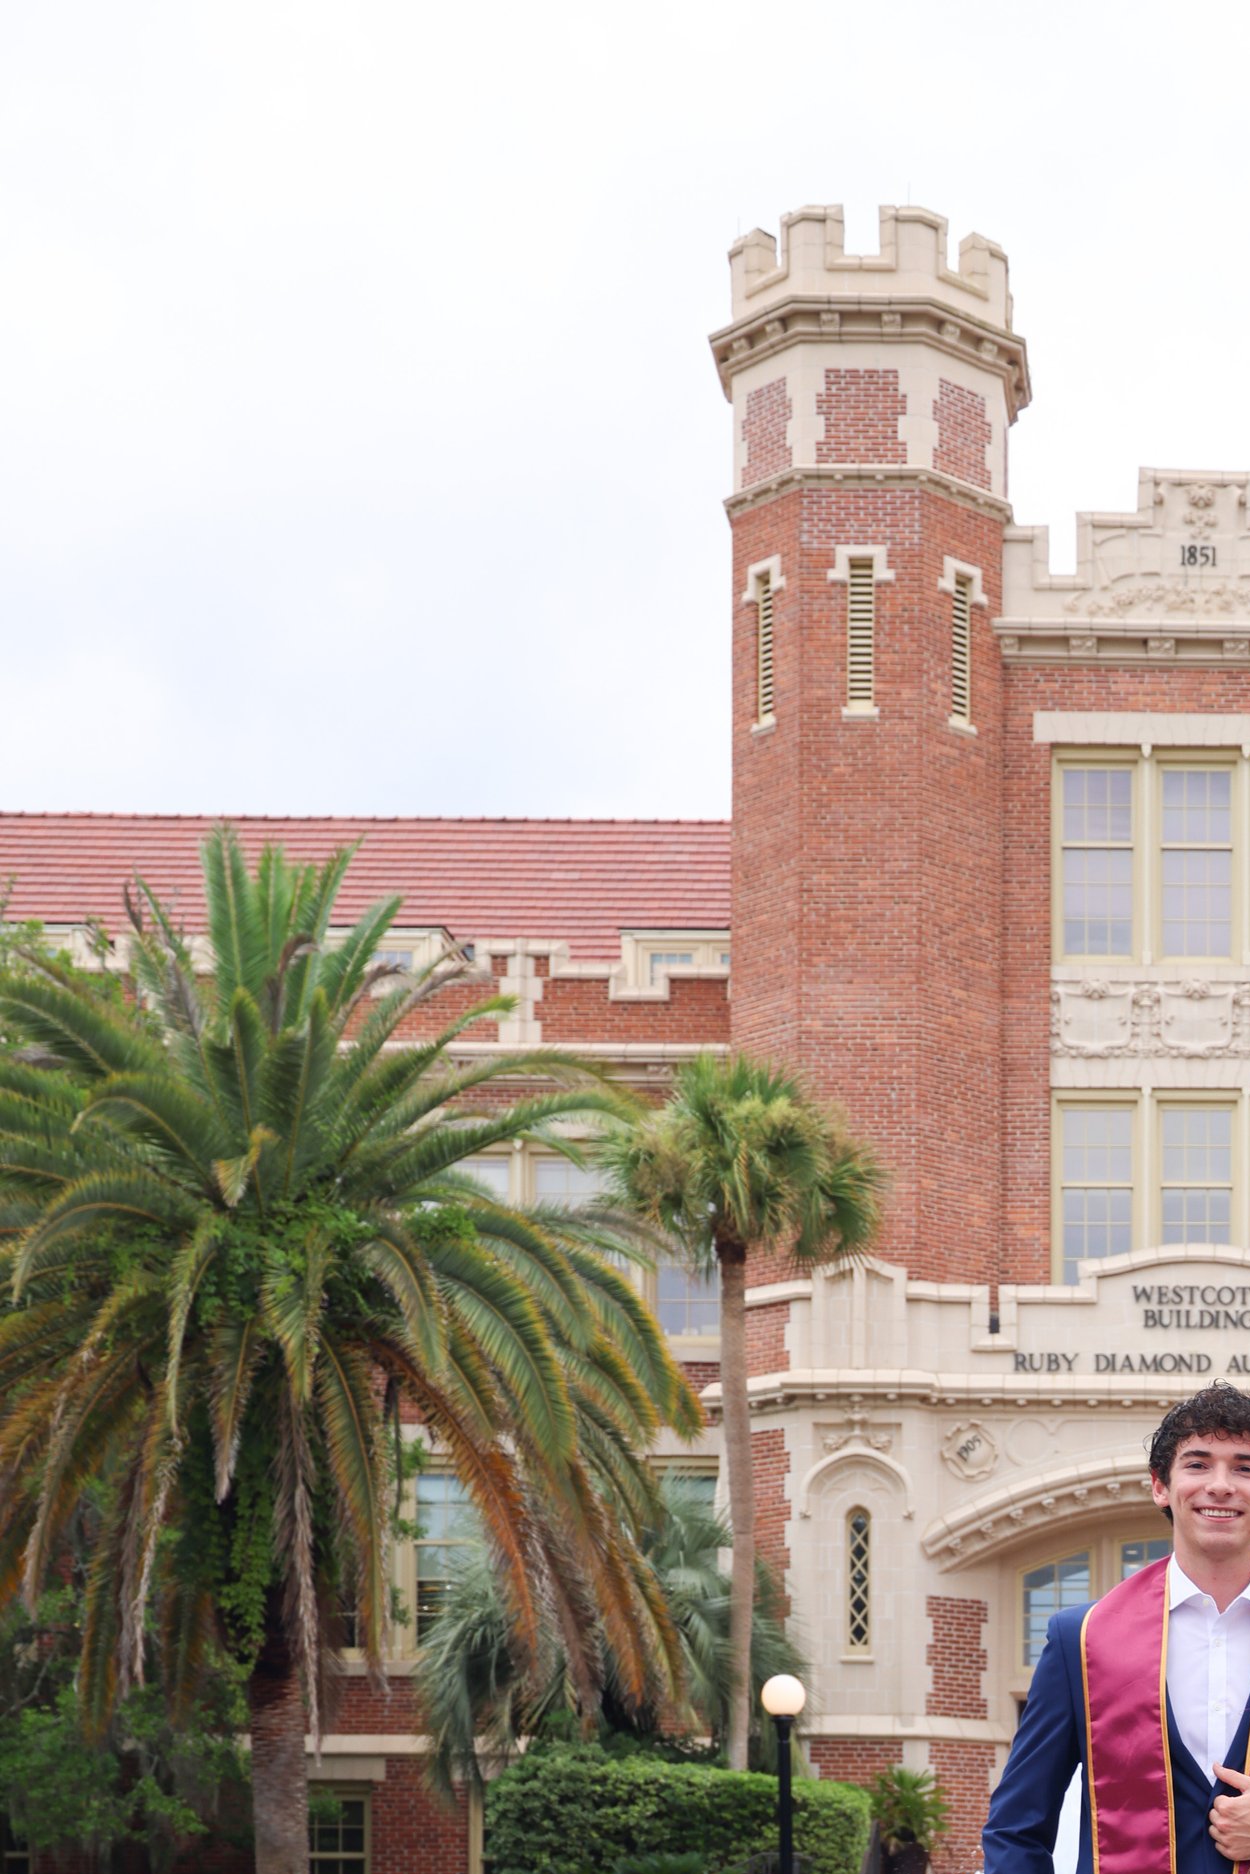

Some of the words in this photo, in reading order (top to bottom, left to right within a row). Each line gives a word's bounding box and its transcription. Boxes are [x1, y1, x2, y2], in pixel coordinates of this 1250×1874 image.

[1180, 545, 1217, 567] 1851
[1013, 1353, 1079, 1373] RUBY
[1094, 1353, 1211, 1374] DIAMOND
